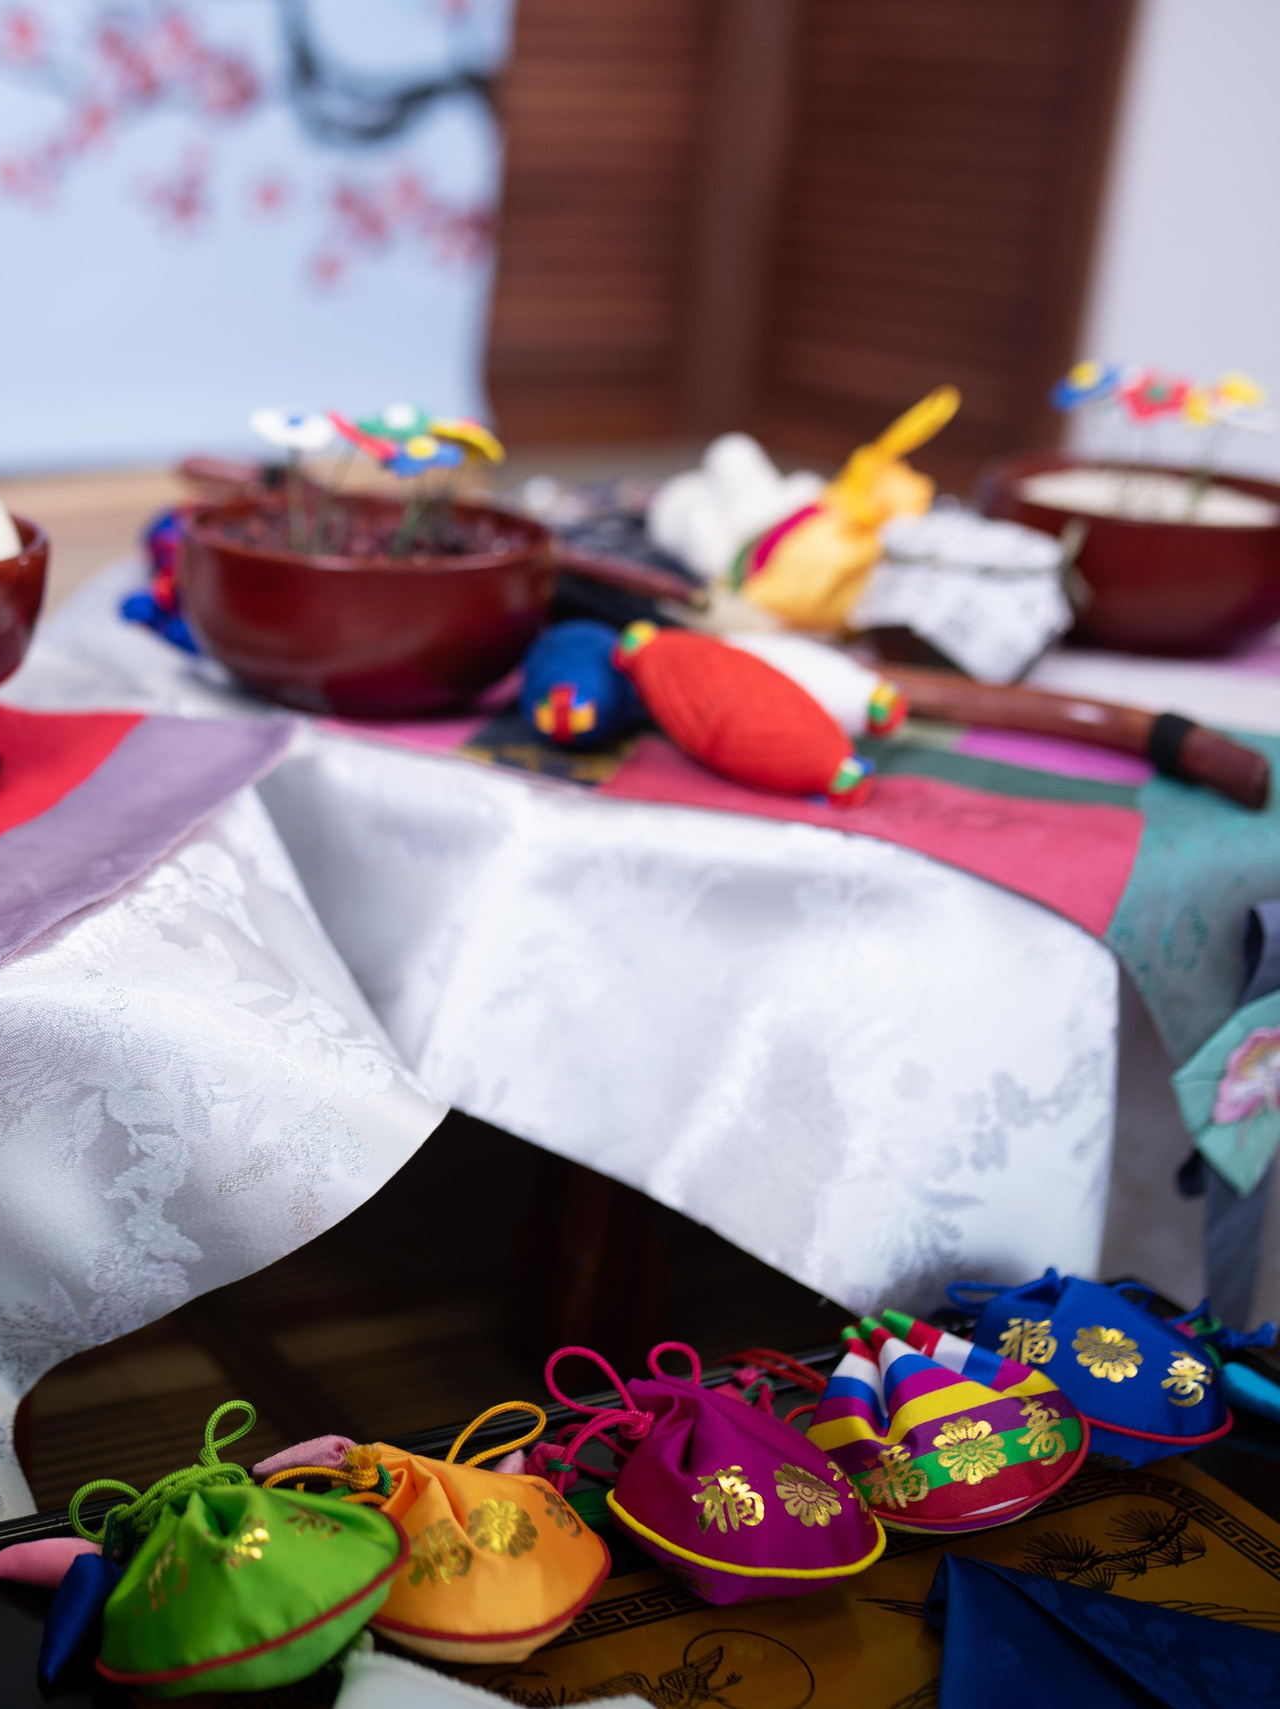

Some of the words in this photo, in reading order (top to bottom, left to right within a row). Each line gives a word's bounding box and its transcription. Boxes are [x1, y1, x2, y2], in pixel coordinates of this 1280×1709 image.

[996, 1317, 1058, 1365] 福
[692, 1465, 765, 1534] 福
[861, 1445, 930, 1510] 福
